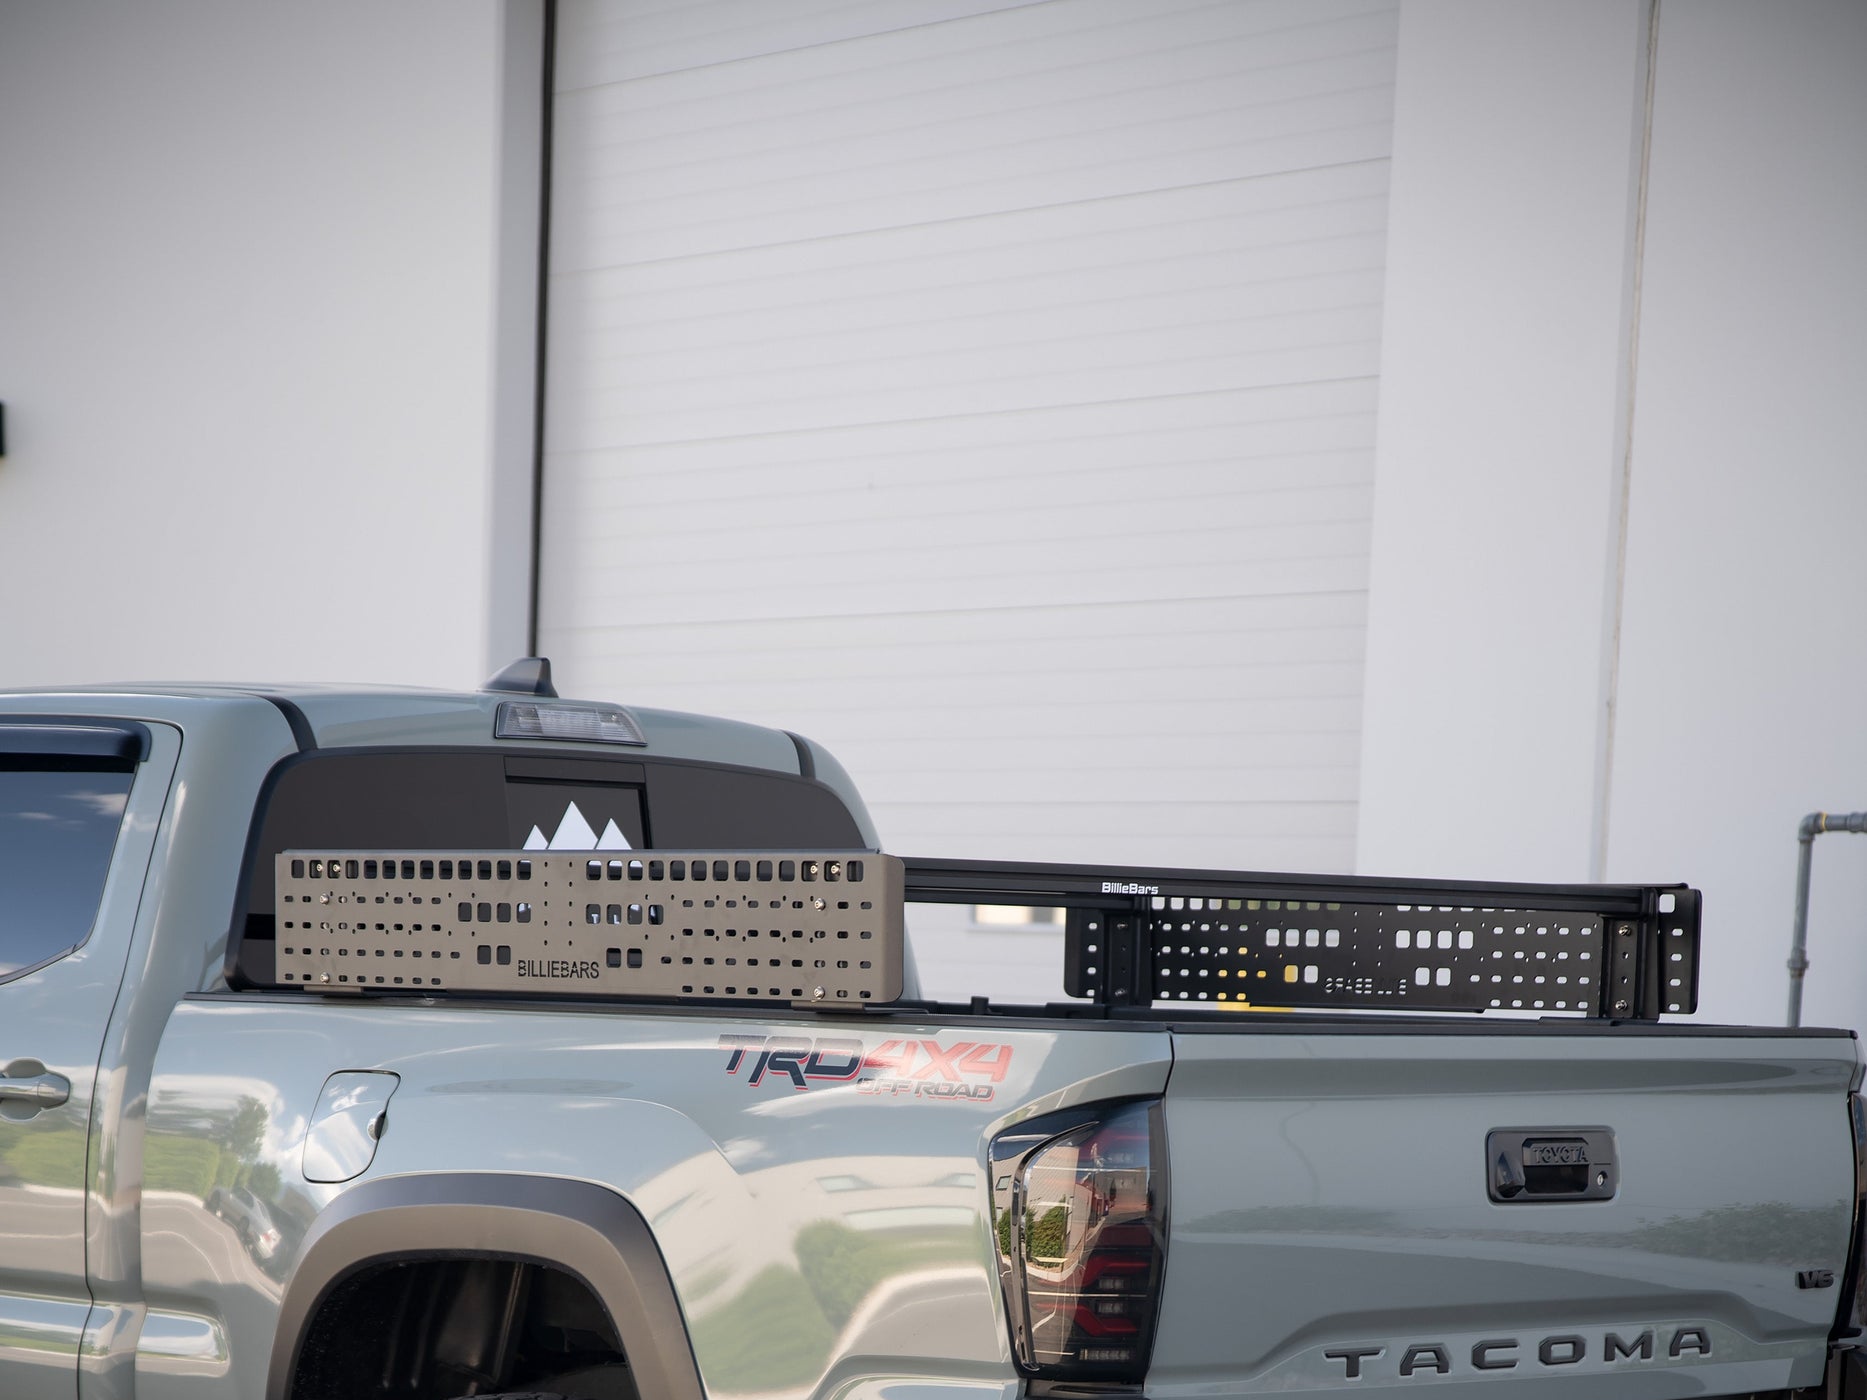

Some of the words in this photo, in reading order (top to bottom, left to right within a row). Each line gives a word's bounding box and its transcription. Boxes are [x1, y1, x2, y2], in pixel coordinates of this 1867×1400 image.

[1101, 882, 1159, 895] BillieBars
[518, 960, 600, 979] BILLIEBARS
[717, 1034, 864, 1090] TRD
[856, 1077, 911, 1096] OFF
[914, 1080, 995, 1102] ROAD
[1533, 1145, 1589, 1164] TOYOTA
[1795, 1269, 1835, 1290] V6
[1323, 1327, 1712, 1381] TACOMA
